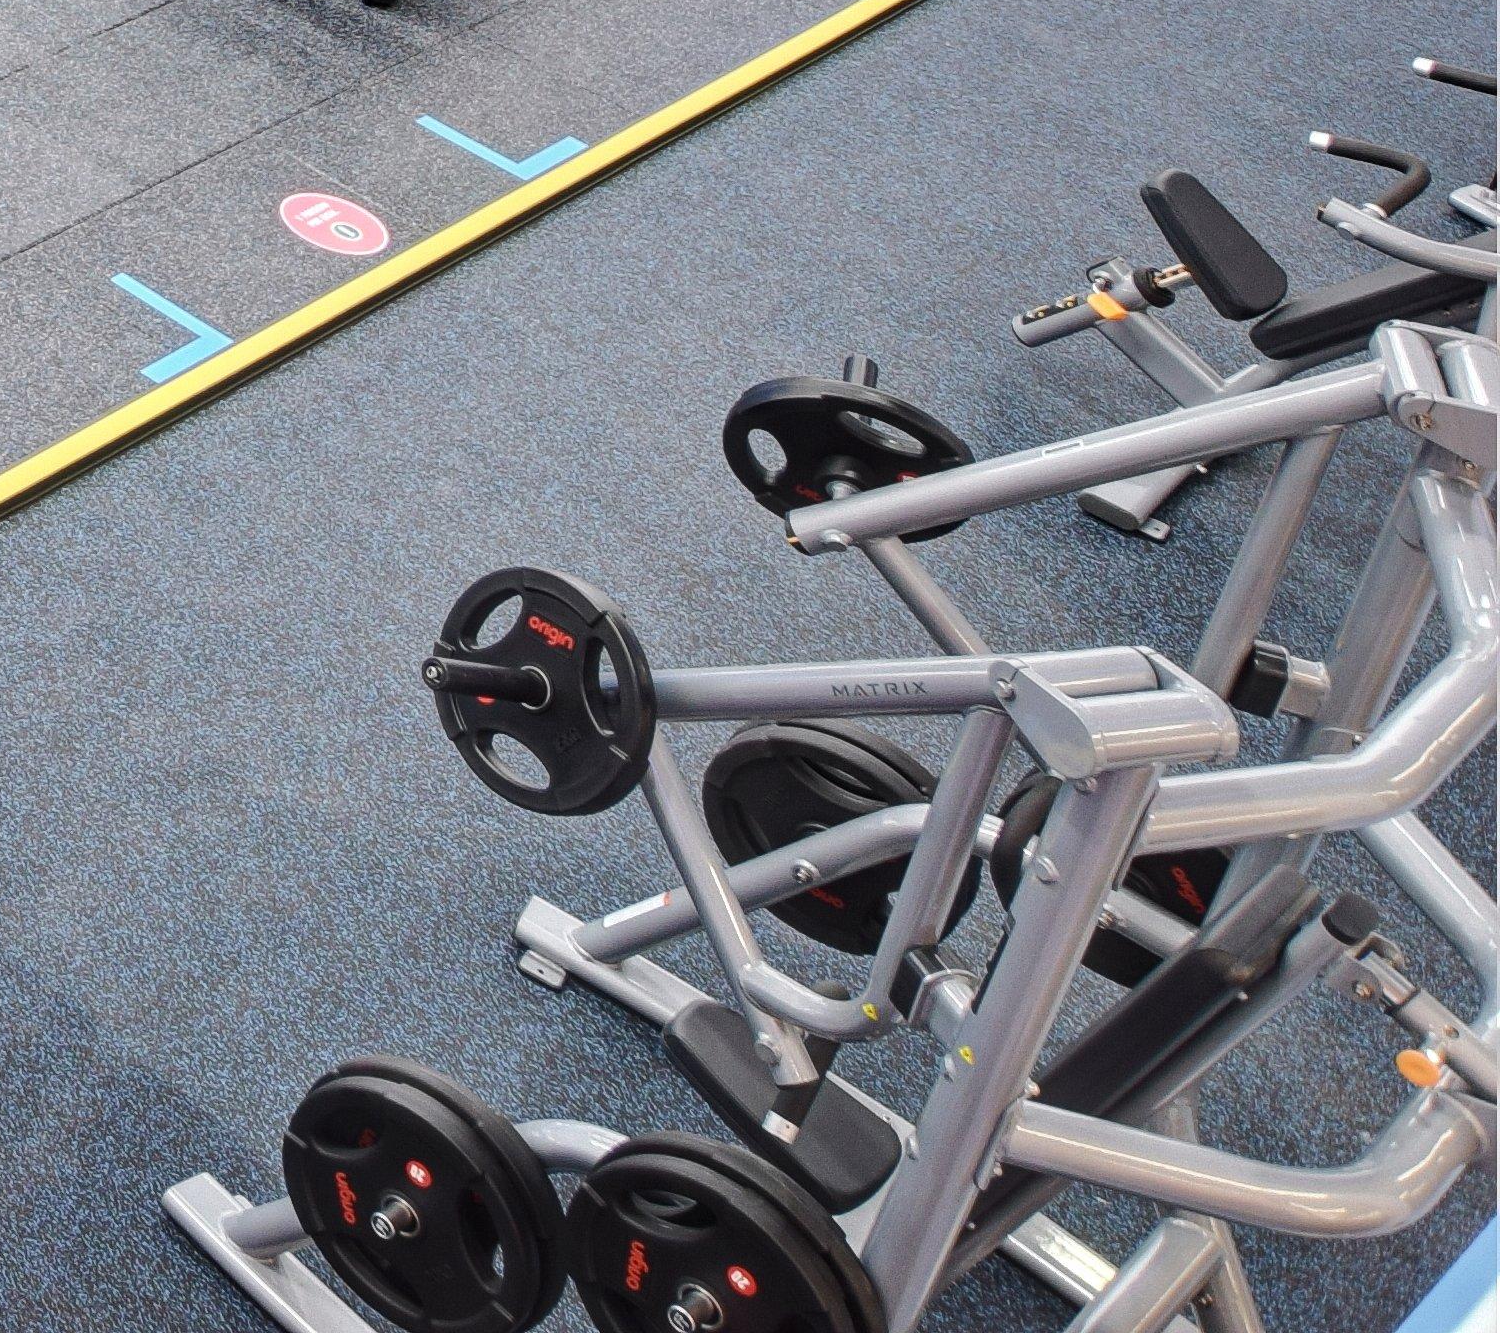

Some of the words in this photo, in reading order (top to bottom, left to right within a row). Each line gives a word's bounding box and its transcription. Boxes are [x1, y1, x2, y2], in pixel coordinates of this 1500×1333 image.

[529, 616, 574, 649] origin
[831, 680, 928, 698] MATRIX
[334, 1171, 357, 1225] origin
[625, 1240, 649, 1292] origin
